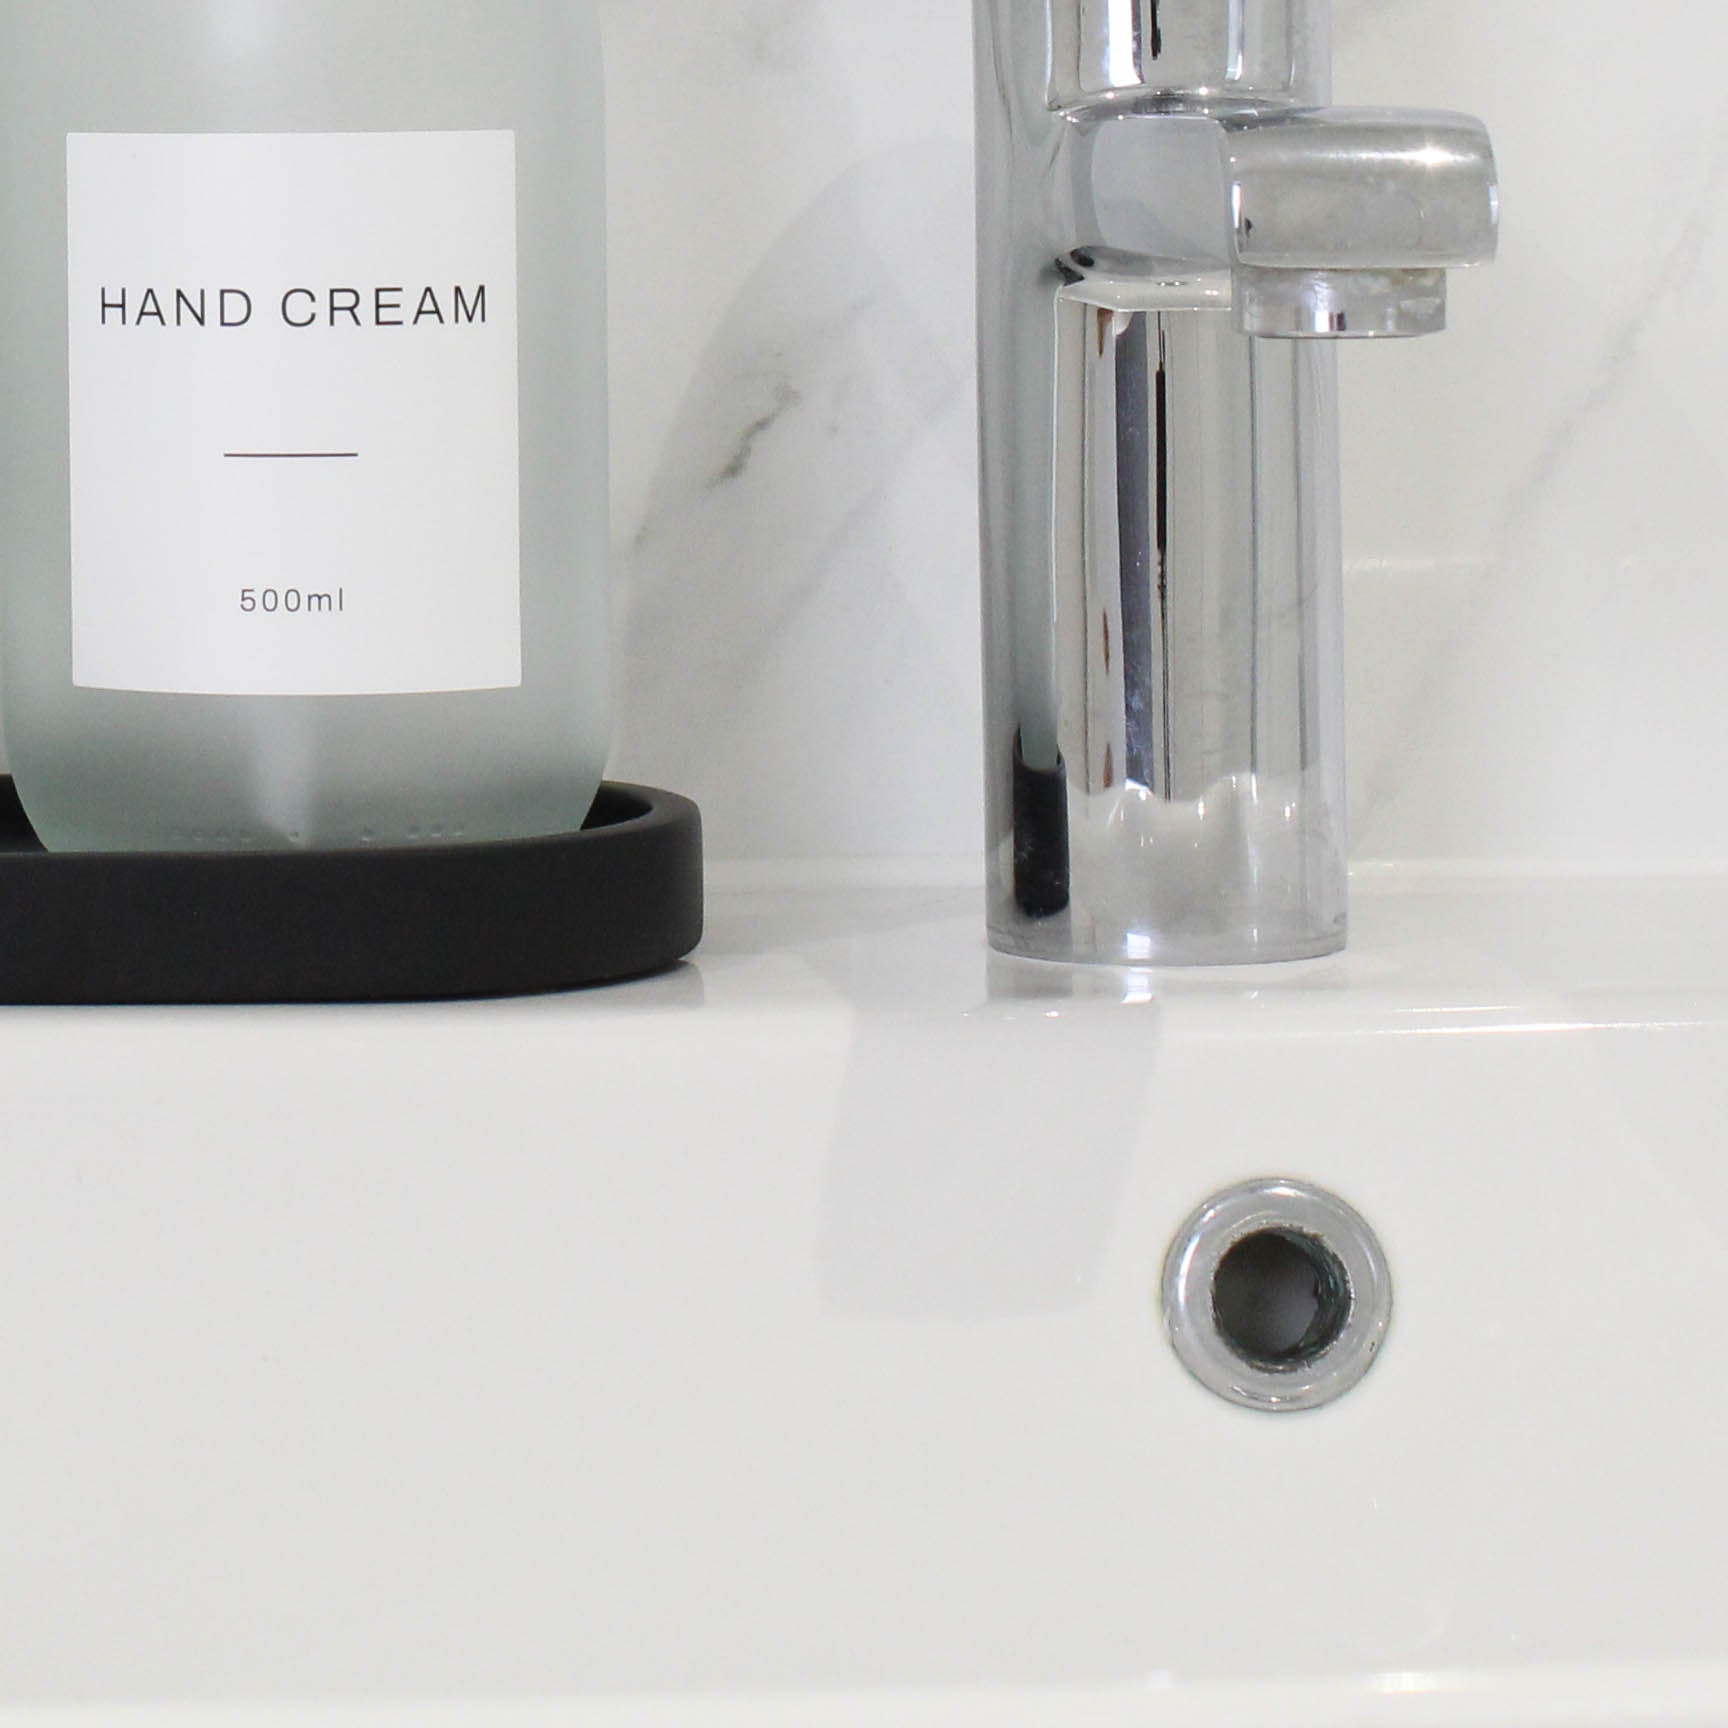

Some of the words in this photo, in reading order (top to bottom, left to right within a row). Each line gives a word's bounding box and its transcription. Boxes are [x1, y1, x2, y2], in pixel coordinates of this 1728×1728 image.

[99, 285, 253, 328] HAND
[280, 283, 487, 329] CREAM
[239, 586, 344, 614] 500ml
